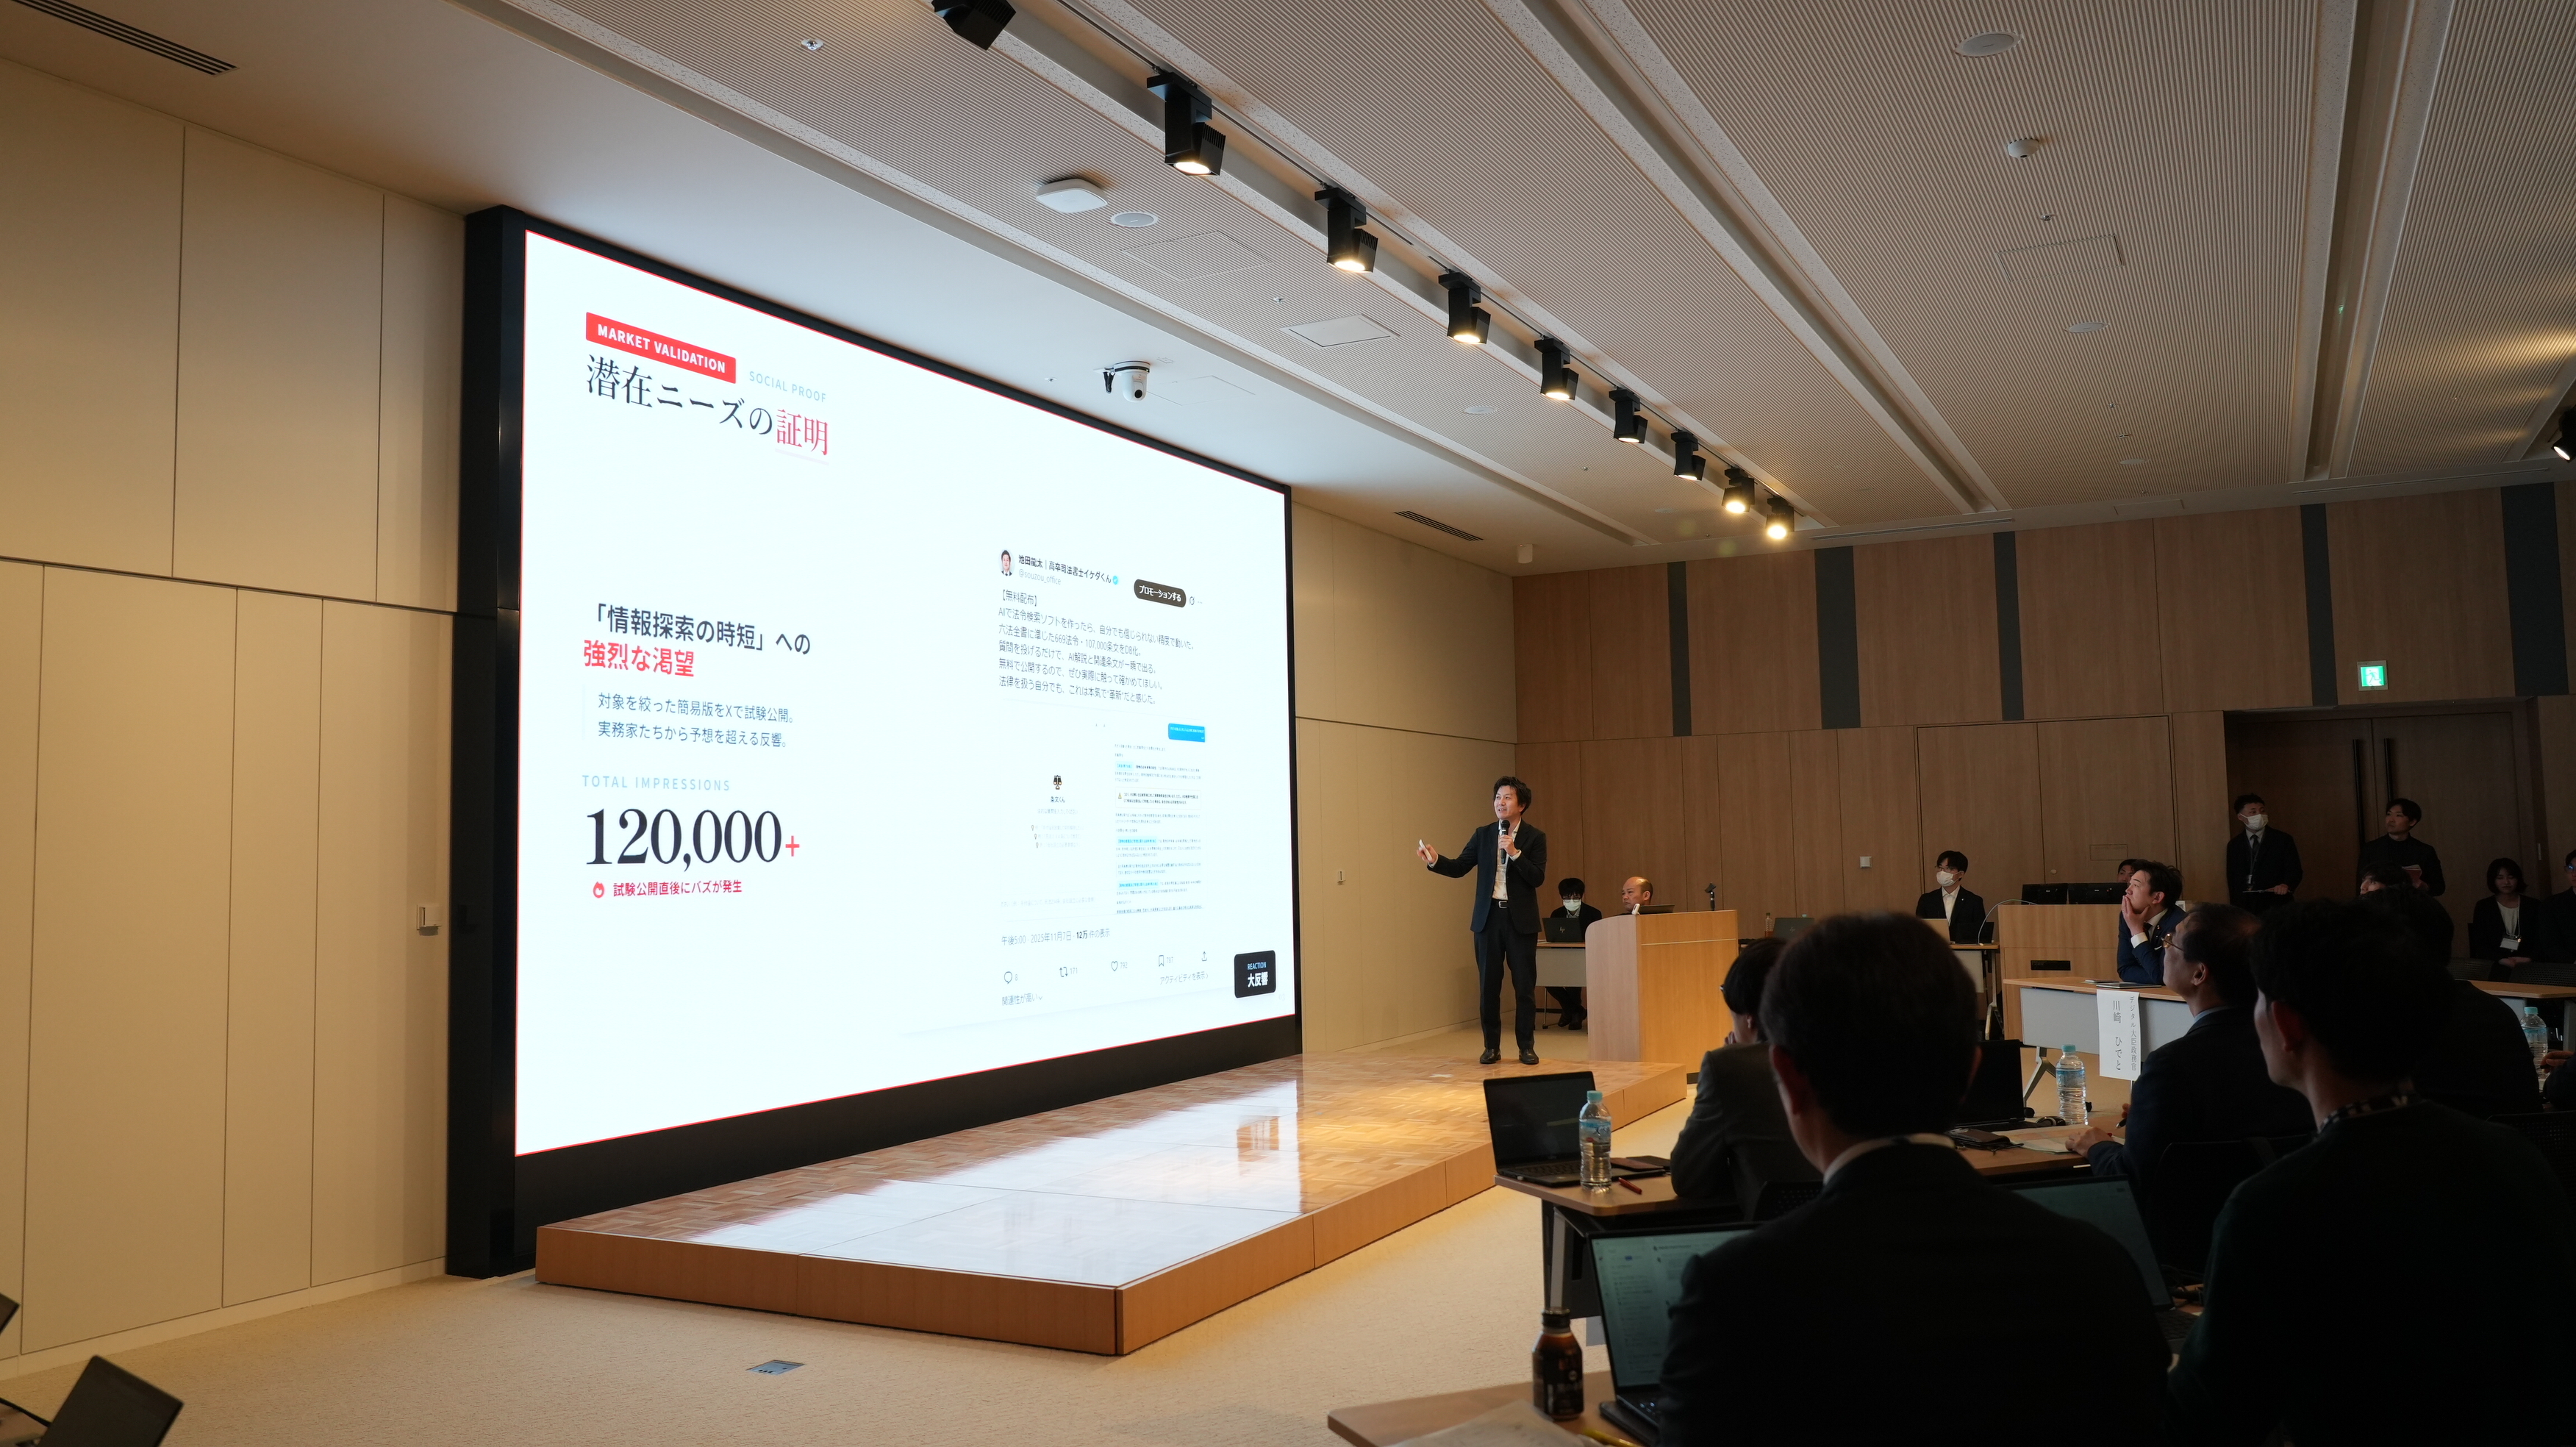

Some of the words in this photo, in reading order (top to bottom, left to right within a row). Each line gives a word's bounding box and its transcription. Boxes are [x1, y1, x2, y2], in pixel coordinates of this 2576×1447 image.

[597, 324, 651, 351] MARKET
[654, 340, 726, 374] VALIDATION
[749, 371, 787, 392] SOCIAL
[792, 385, 827, 403] PROOF
[586, 354, 829, 456] 潜在ニーズの証明
[1018, 568, 1062, 585] @souzou_office
[1002, 589, 1037, 607] 【無料配布】
[1139, 585, 1182, 602] プロモーションする
[598, 603, 811, 655] 「情報探索の時短」への
[584, 639, 695, 677] 強烈な渇望
[598, 692, 793, 724] 対象を絞った簡易版をXで試験公開。
[598, 721, 787, 748] 実務家たちから予想を超える反響。
[582, 775, 628, 788] TOTAL
[635, 776, 730, 791] IMPRESSIONS
[612, 879, 743, 897] 試験公開直後にバズが発生
[1076, 930, 1088, 940] 12万
[1247, 962, 1267, 971] REACTION
[1247, 971, 1268, 988] 大反響
